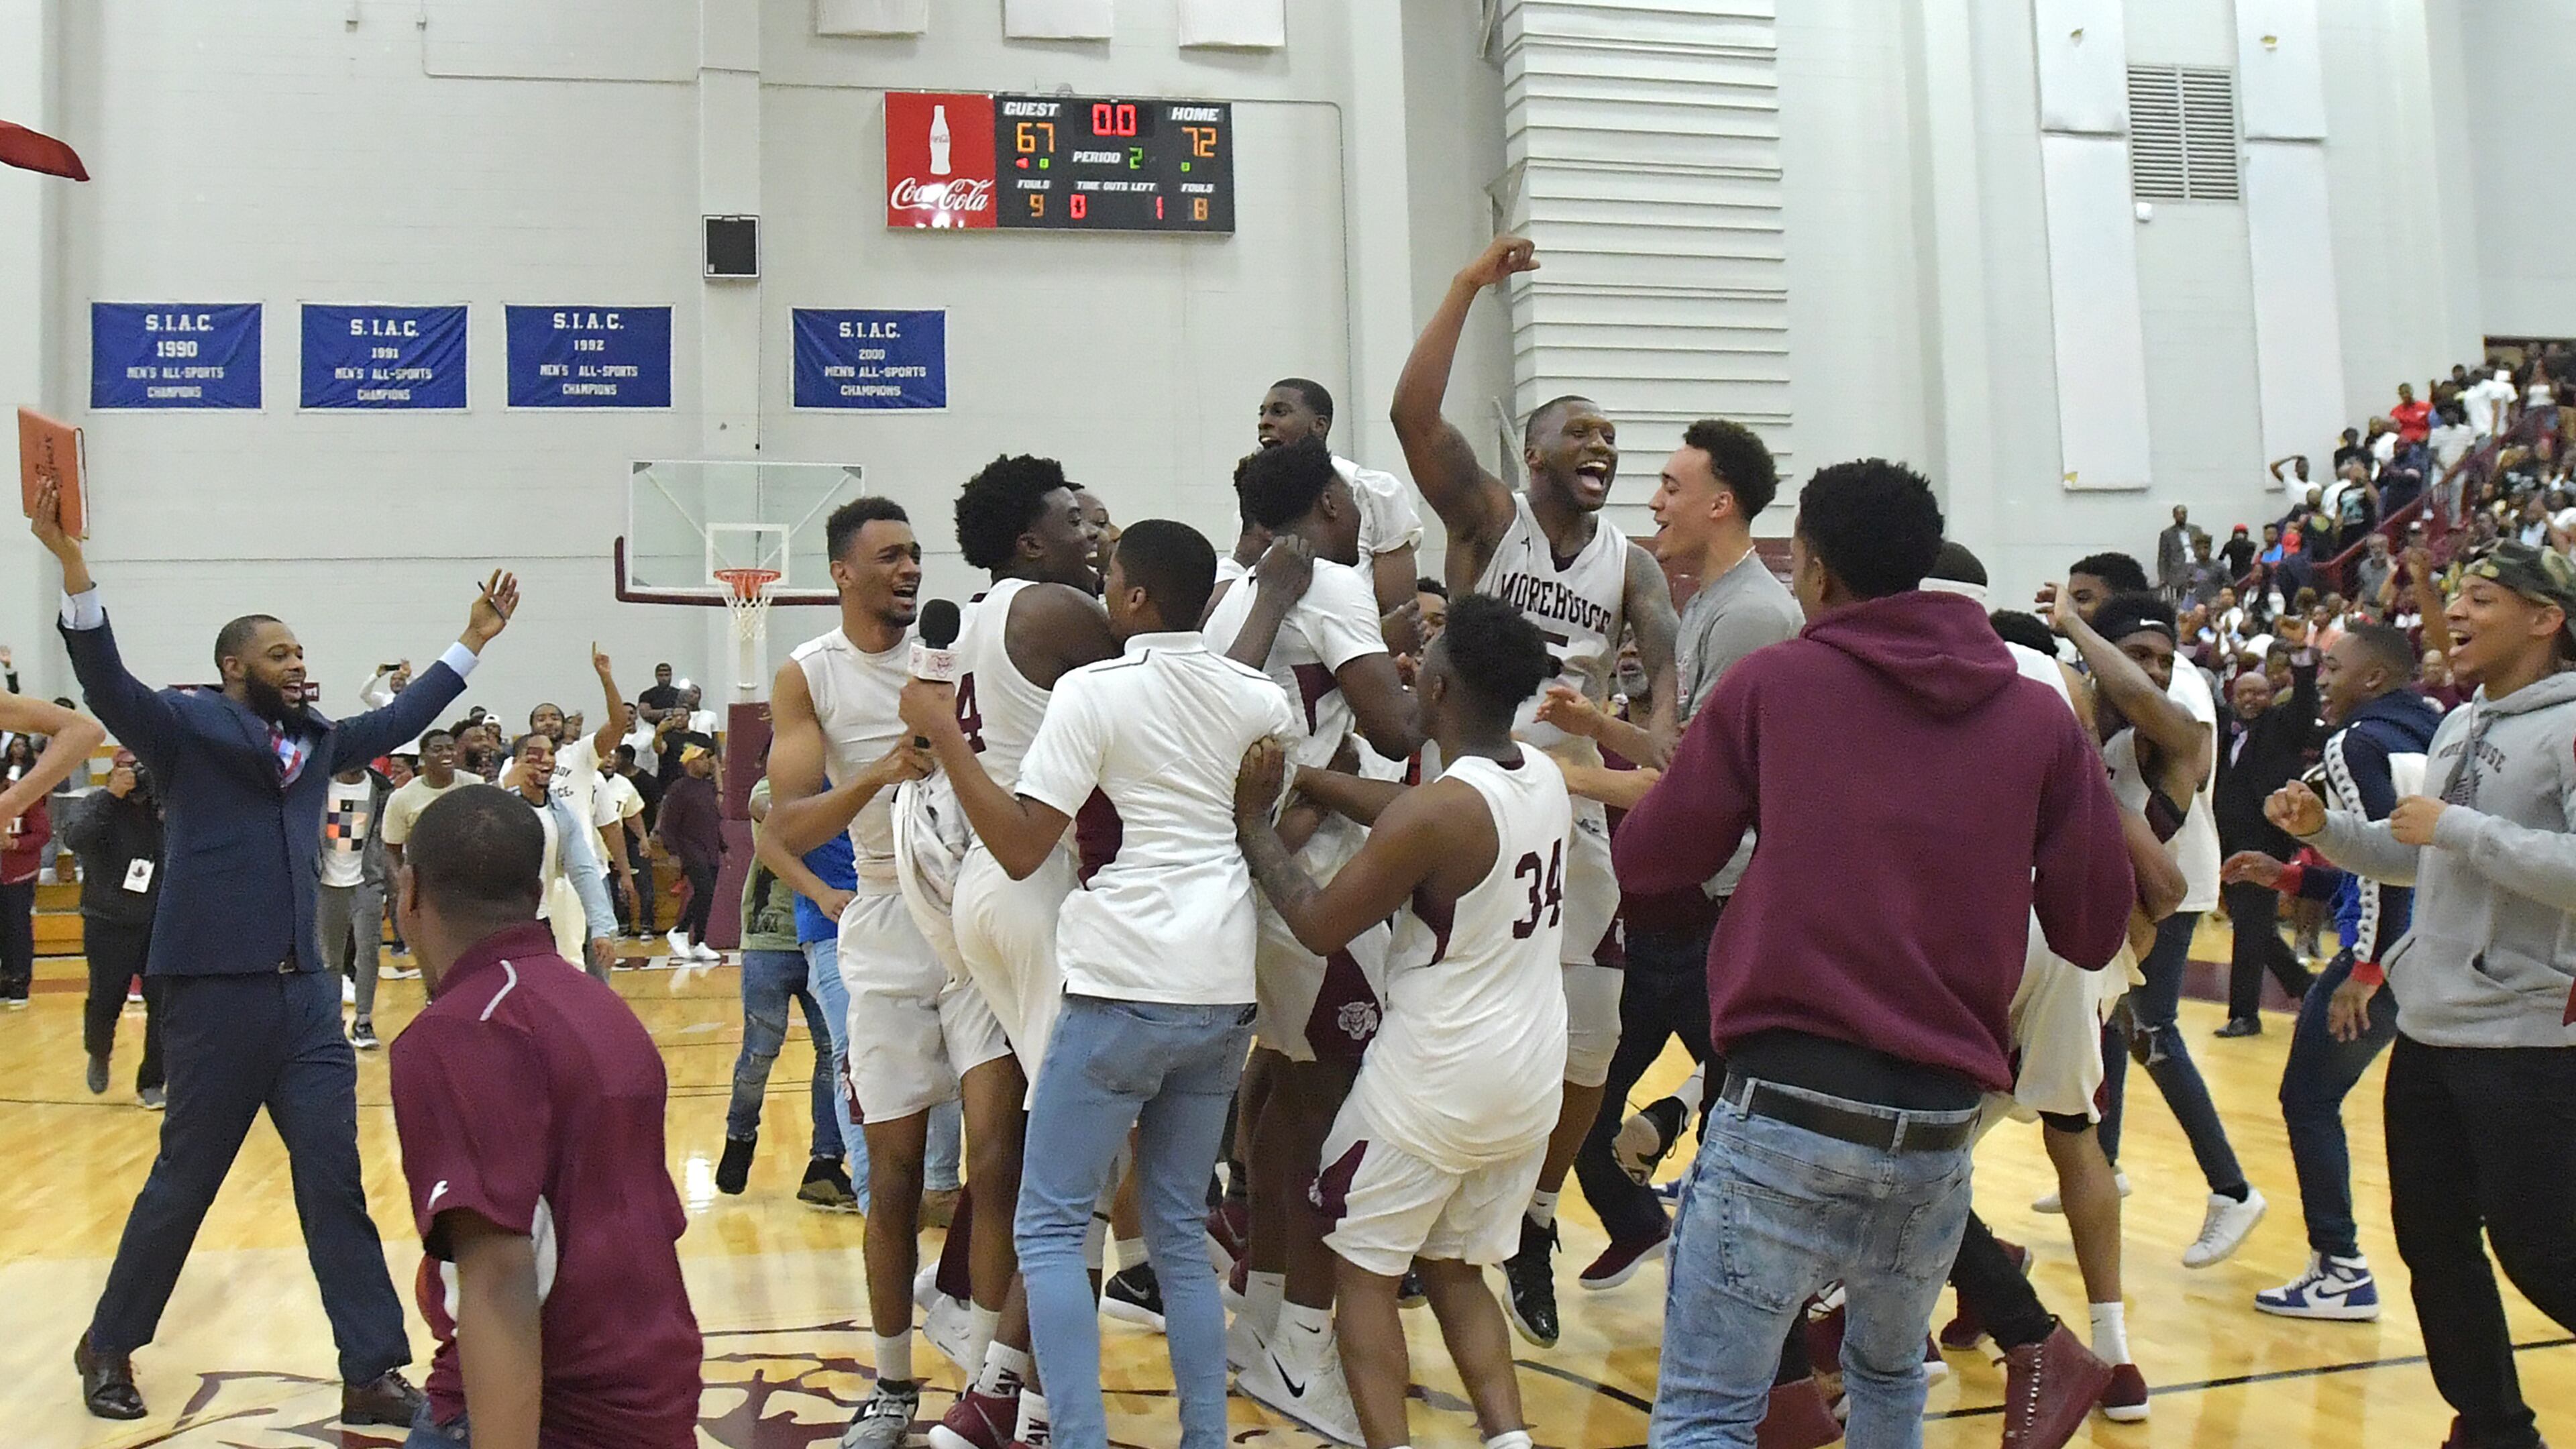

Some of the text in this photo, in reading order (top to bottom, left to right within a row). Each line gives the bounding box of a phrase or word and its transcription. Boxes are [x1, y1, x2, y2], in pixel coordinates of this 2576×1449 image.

[1004, 102, 1060, 117] GUEST
[1171, 107, 1220, 121] HOME
[1017, 122, 1055, 153] 67
[1181, 126, 1217, 157] 72
[1073, 150, 1122, 164] PERIOD
[1129, 147, 1143, 169] 2
[1030, 194, 1044, 217] 9
[1070, 194, 1087, 219] 0
[1156, 196, 1164, 220] 1
[1194, 197, 1208, 221] 8
[156, 341, 198, 357] 1990
[372, 347, 398, 358] 1991
[574, 339, 605, 351] 1992
[859, 349, 885, 360] 2000
[1513, 838, 1563, 940] 34
